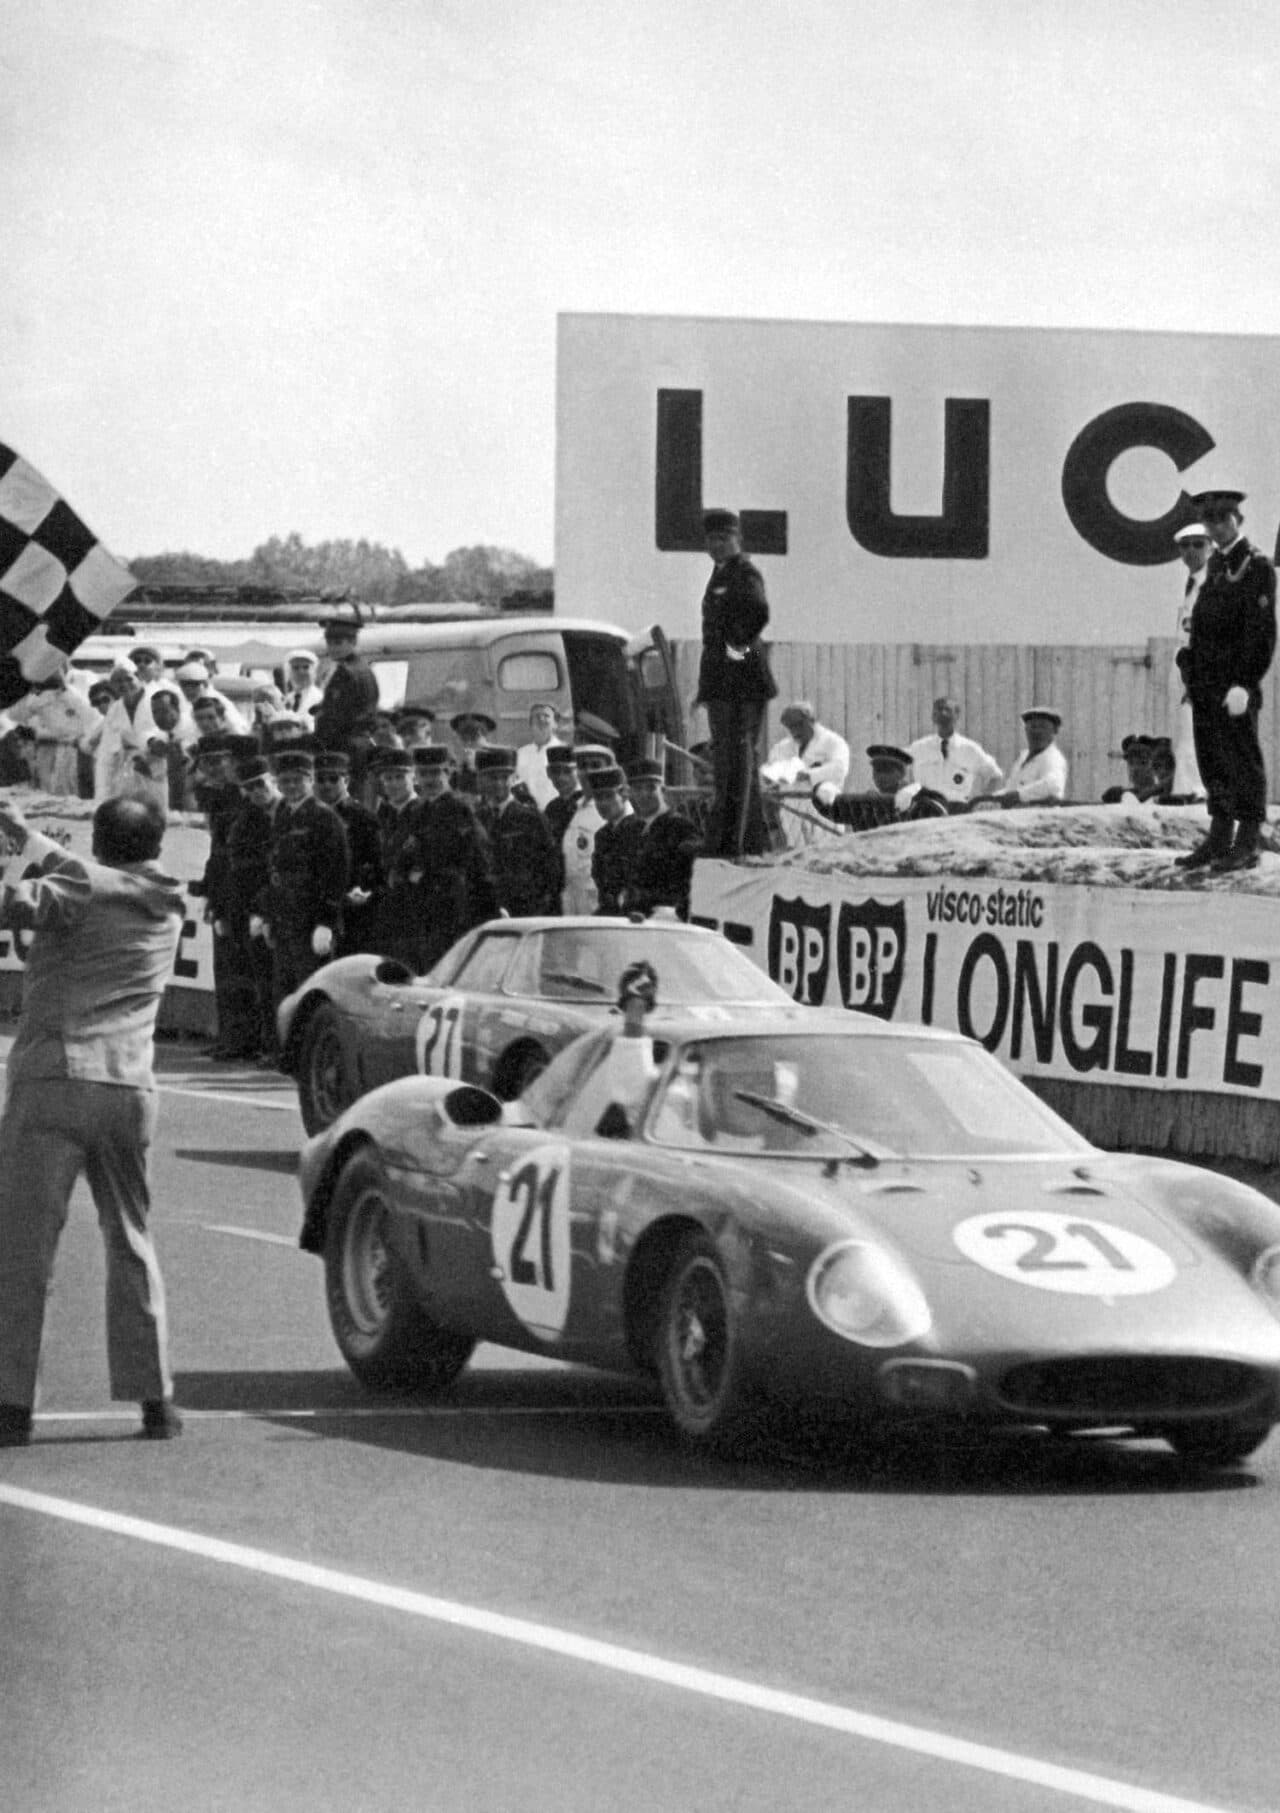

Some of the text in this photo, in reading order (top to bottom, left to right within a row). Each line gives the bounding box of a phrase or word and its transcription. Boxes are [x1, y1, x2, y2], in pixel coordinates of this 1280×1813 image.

[780, 921, 823, 1004] BP
[850, 926, 898, 1005] BP
[509, 1163, 560, 1292] 21
[983, 1223, 1135, 1272] 21
